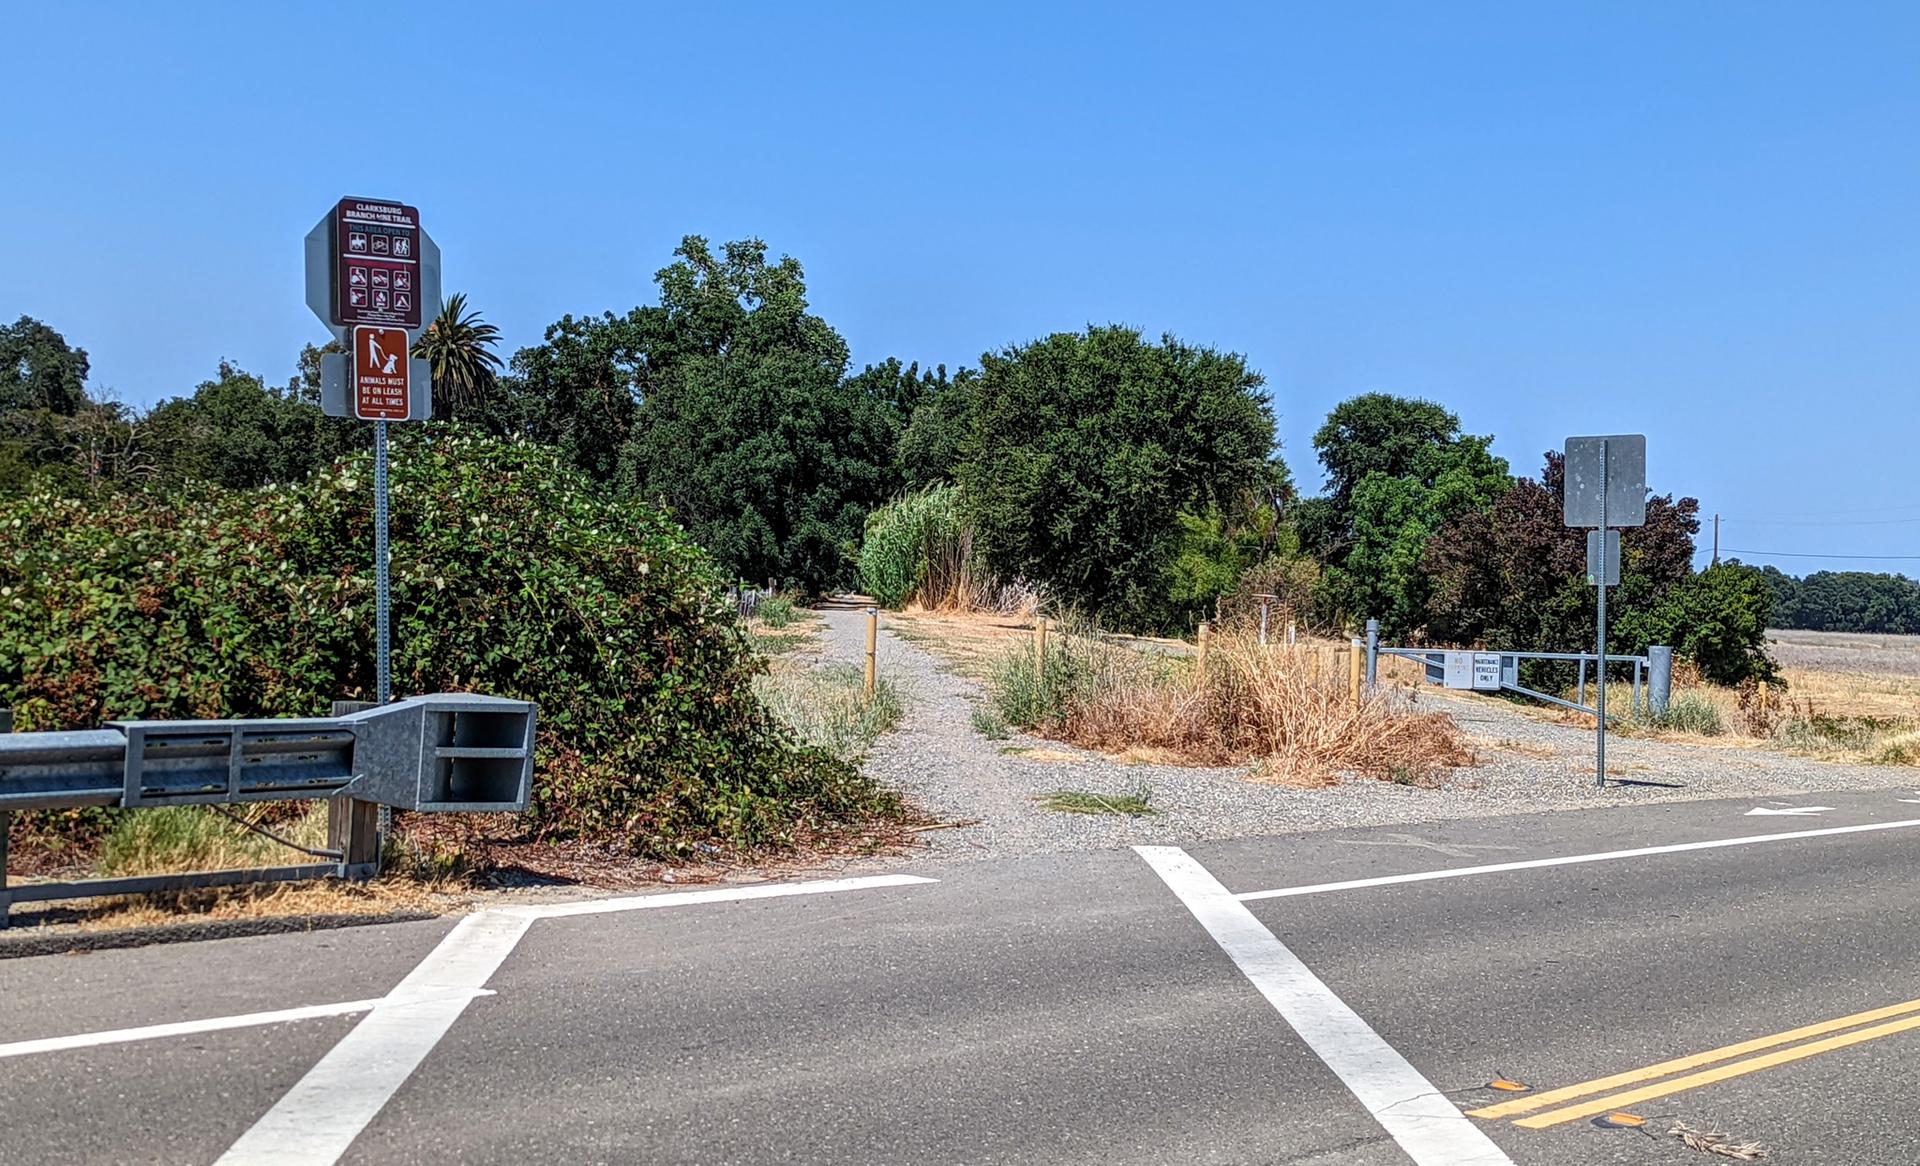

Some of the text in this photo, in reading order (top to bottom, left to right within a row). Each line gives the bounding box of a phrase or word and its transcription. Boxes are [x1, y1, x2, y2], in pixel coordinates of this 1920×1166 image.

[356, 204, 402, 214] CLARKSBURG
[346, 210, 375, 219] BRANCH
[393, 216, 412, 224] TRAIL
[349, 224, 364, 232] THIS
[365, 225, 382, 233] AREA
[383, 227, 400, 235] OPEN
[360, 376, 386, 385] ANIMALS
[362, 386, 371, 394] BE
[383, 387, 402, 395] LEASH
[362, 396, 403, 406] AT ALL TIMES
